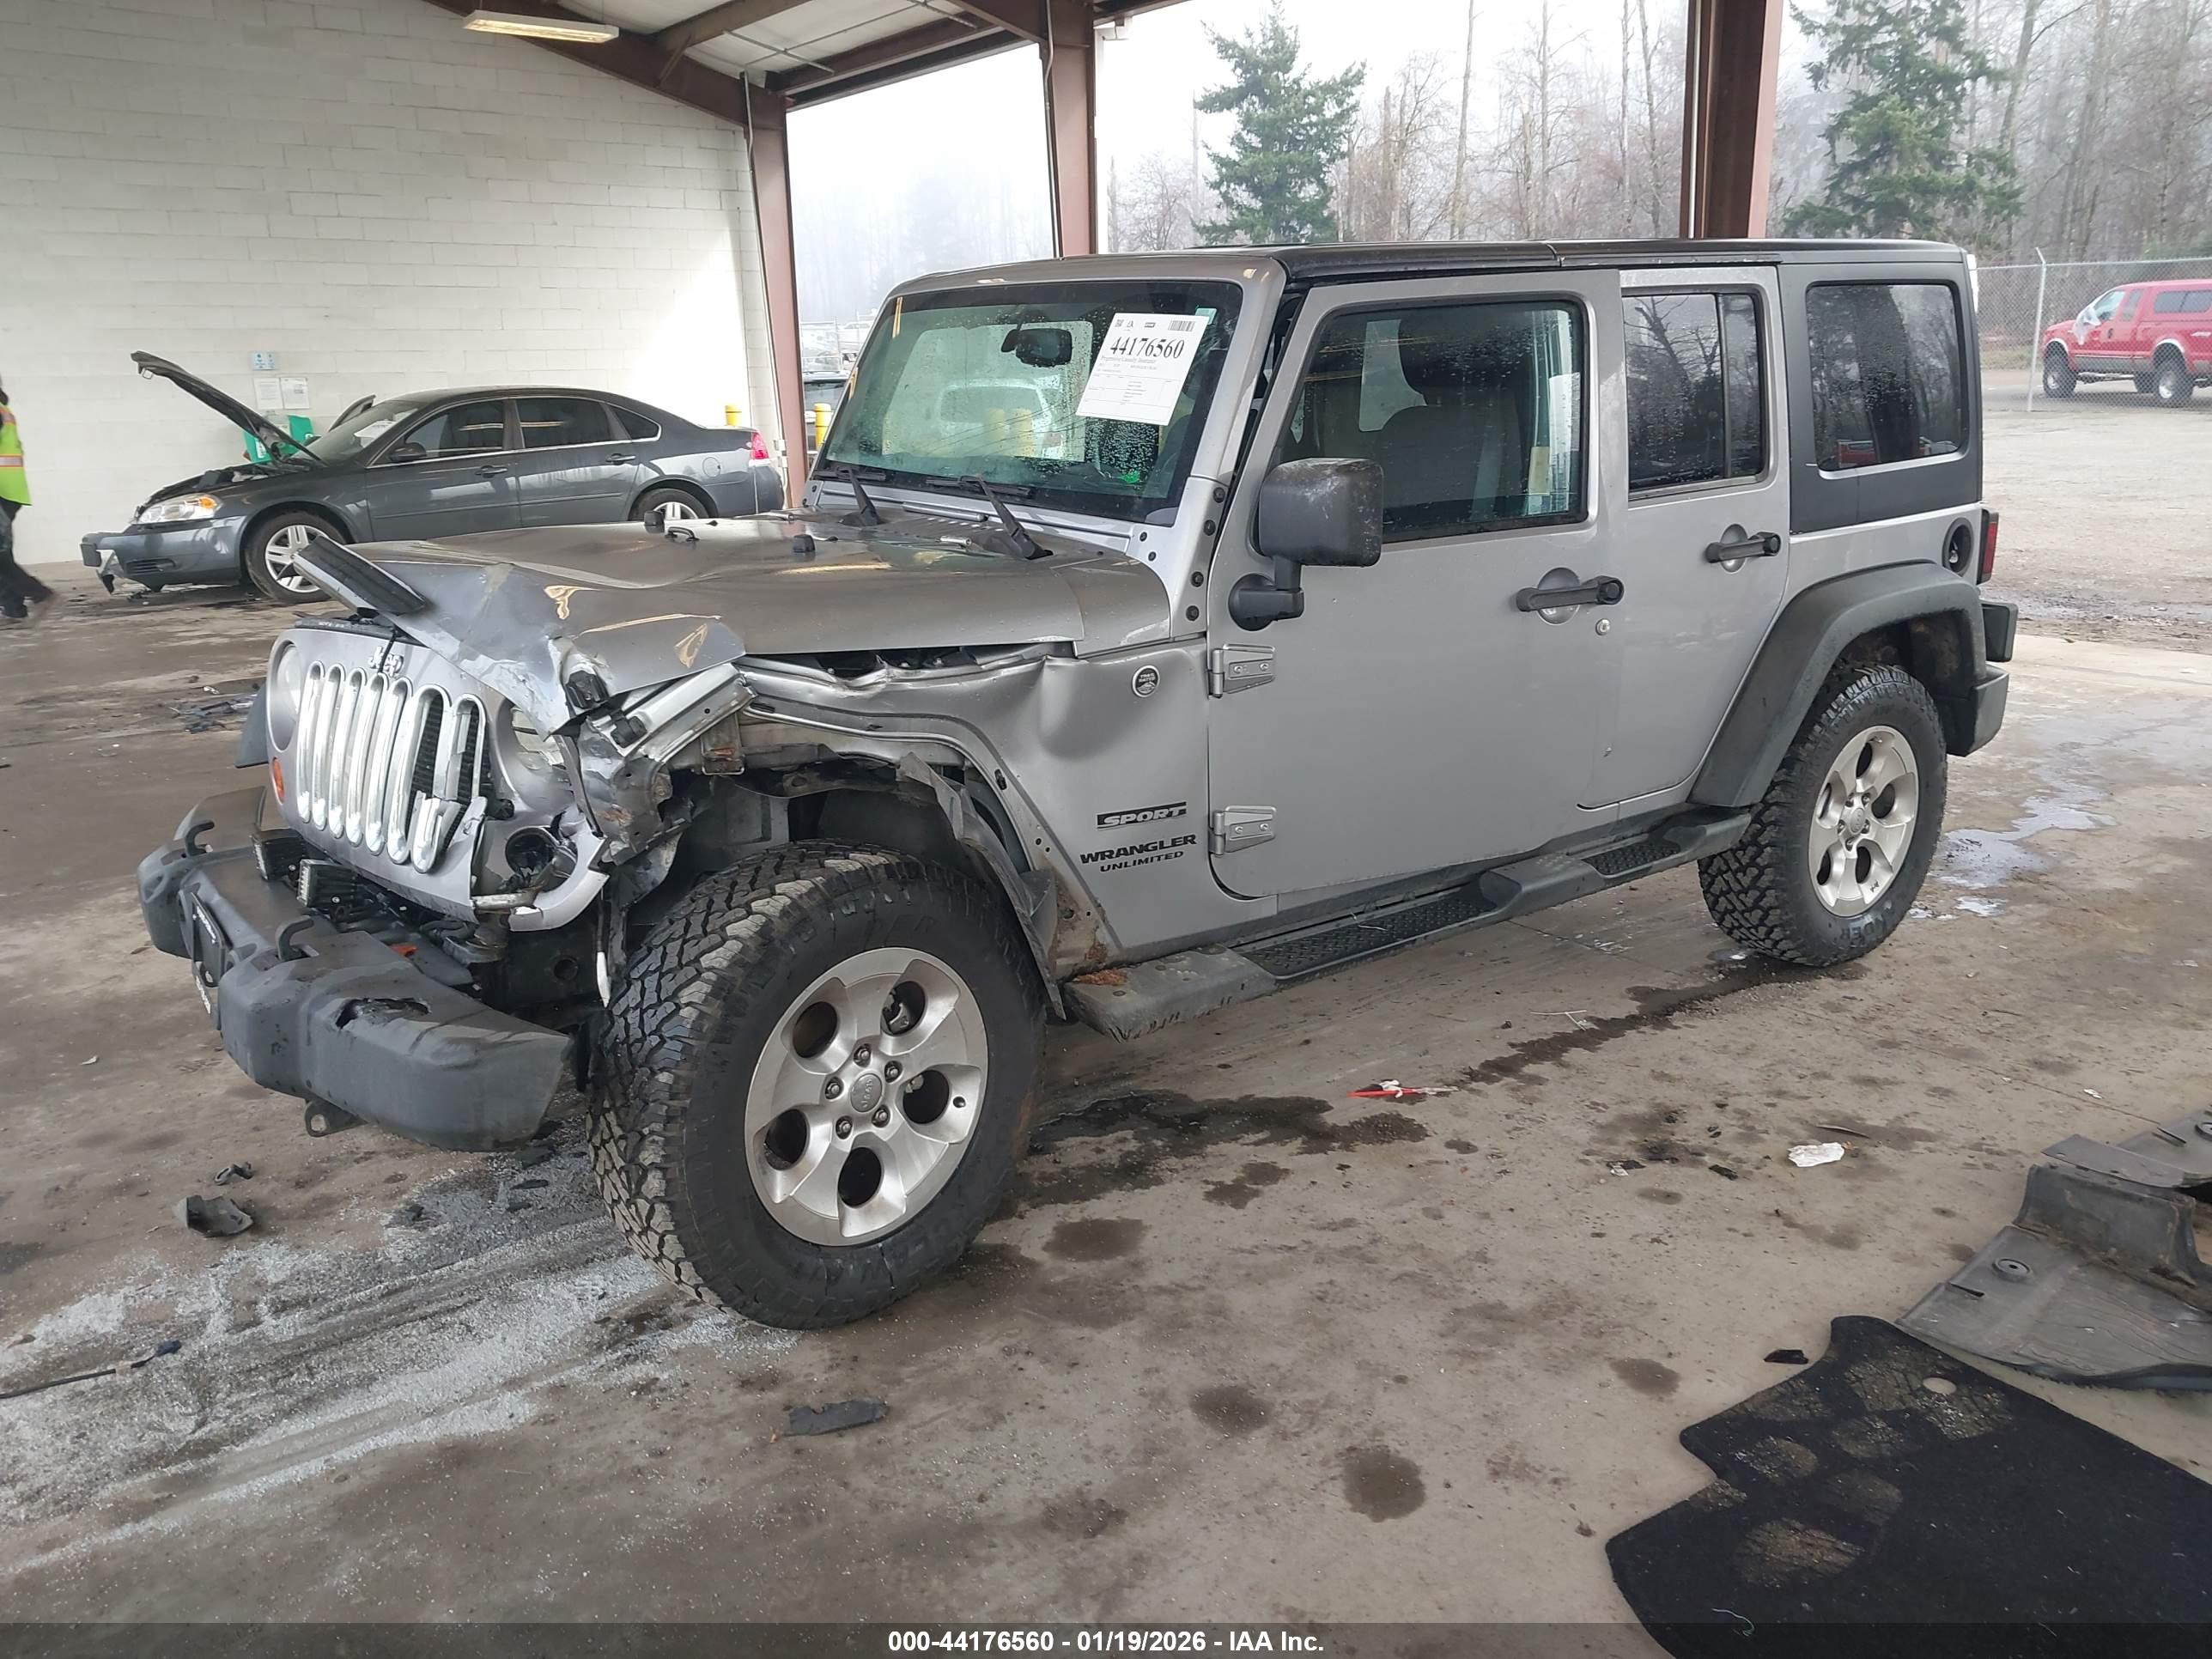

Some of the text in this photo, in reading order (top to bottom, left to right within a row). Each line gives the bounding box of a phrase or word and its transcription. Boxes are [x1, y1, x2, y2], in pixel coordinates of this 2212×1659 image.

[1110, 337, 1185, 359] 44176560
[1103, 808, 1186, 826] SPORT
[1079, 834, 1197, 864] WRANGLER
[1099, 851, 1184, 872] UNLIMITED
